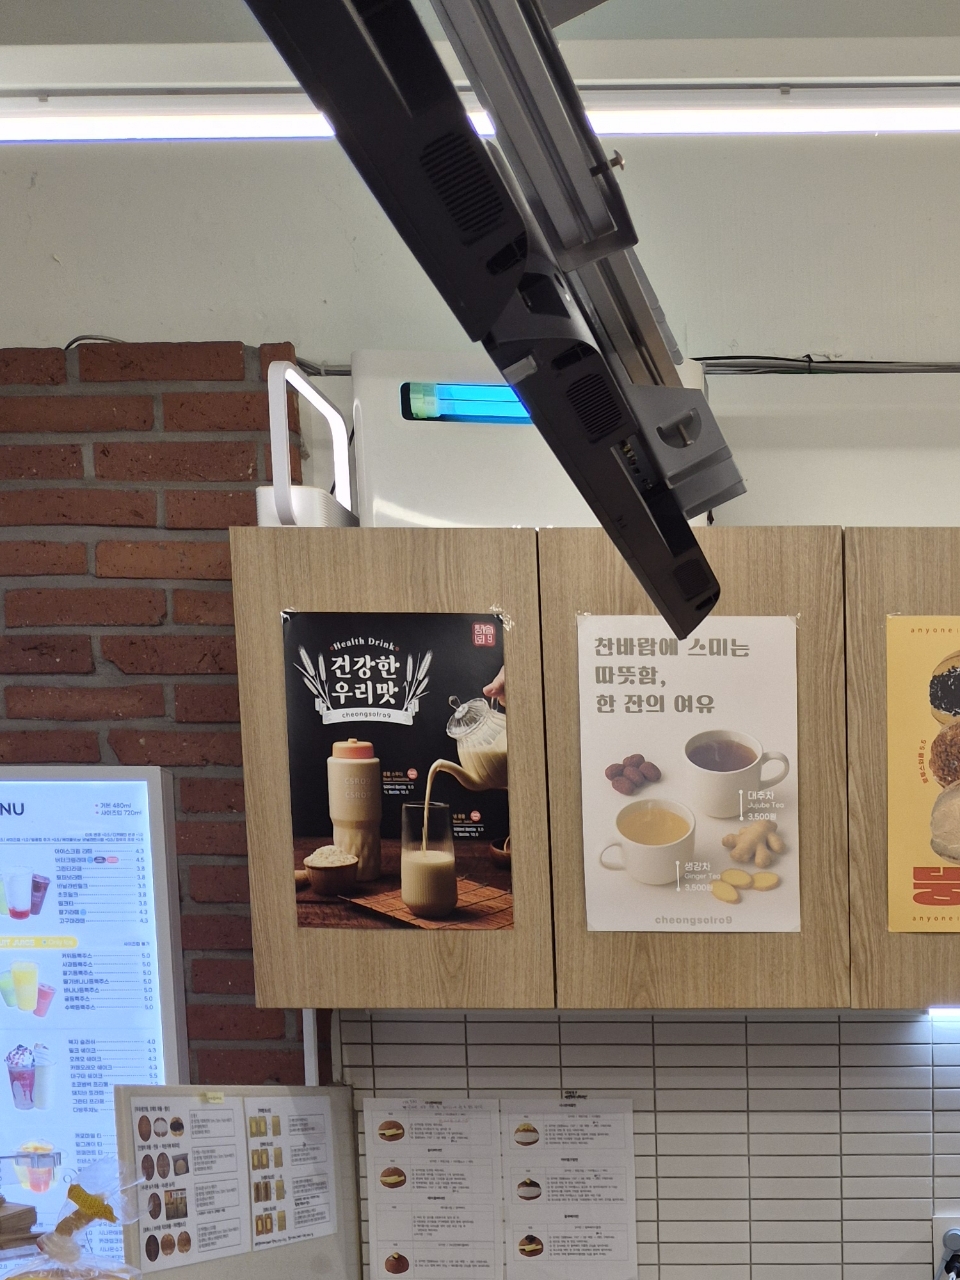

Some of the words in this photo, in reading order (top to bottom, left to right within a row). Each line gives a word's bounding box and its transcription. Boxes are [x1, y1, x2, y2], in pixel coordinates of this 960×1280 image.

[333, 637, 364, 651] Health
[368, 638, 395, 651] Drink
[594, 637, 678, 656] 찬바람에
[687, 638, 750, 658] 스미는
[330, 654, 400, 679] 건강한
[595, 666, 666, 688] 따뜻함,
[331, 680, 399, 705] 우리맛
[596, 694, 616, 714] 한
[624, 694, 665, 714] 잔의
[674, 694, 716, 714] 여유
[748, 791, 774, 800] 대추차
[684, 862, 710, 872] 생강차
[654, 916, 732, 926] cheongsolro9
